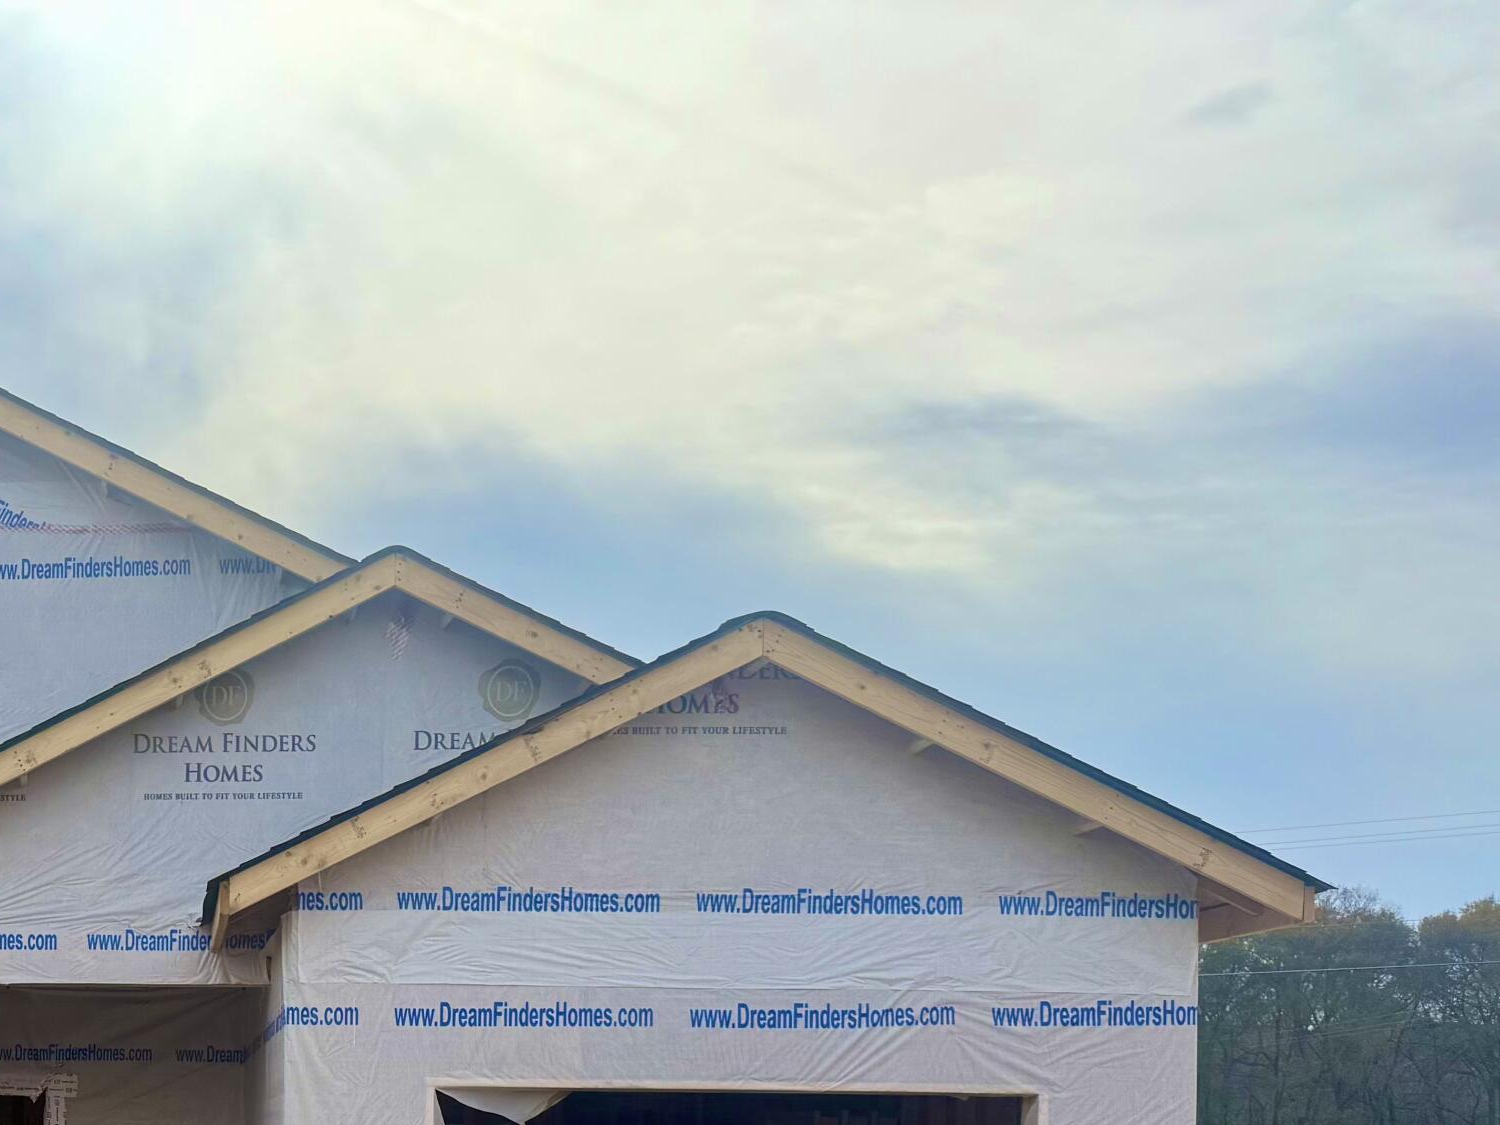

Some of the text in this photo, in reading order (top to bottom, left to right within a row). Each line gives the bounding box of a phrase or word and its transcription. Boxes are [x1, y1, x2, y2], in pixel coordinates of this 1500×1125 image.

[133, 733, 316, 754] DREAM FINDERS
[184, 763, 263, 783] HOMES
[397, 886, 660, 913] www.DreamFindersHomes.com
[696, 887, 963, 915] www.DreamFindersHomes.com
[394, 1001, 654, 1027] www.DreamFindersHomes.com
[689, 1002, 955, 1029] www.DreamFindersHomes.com
